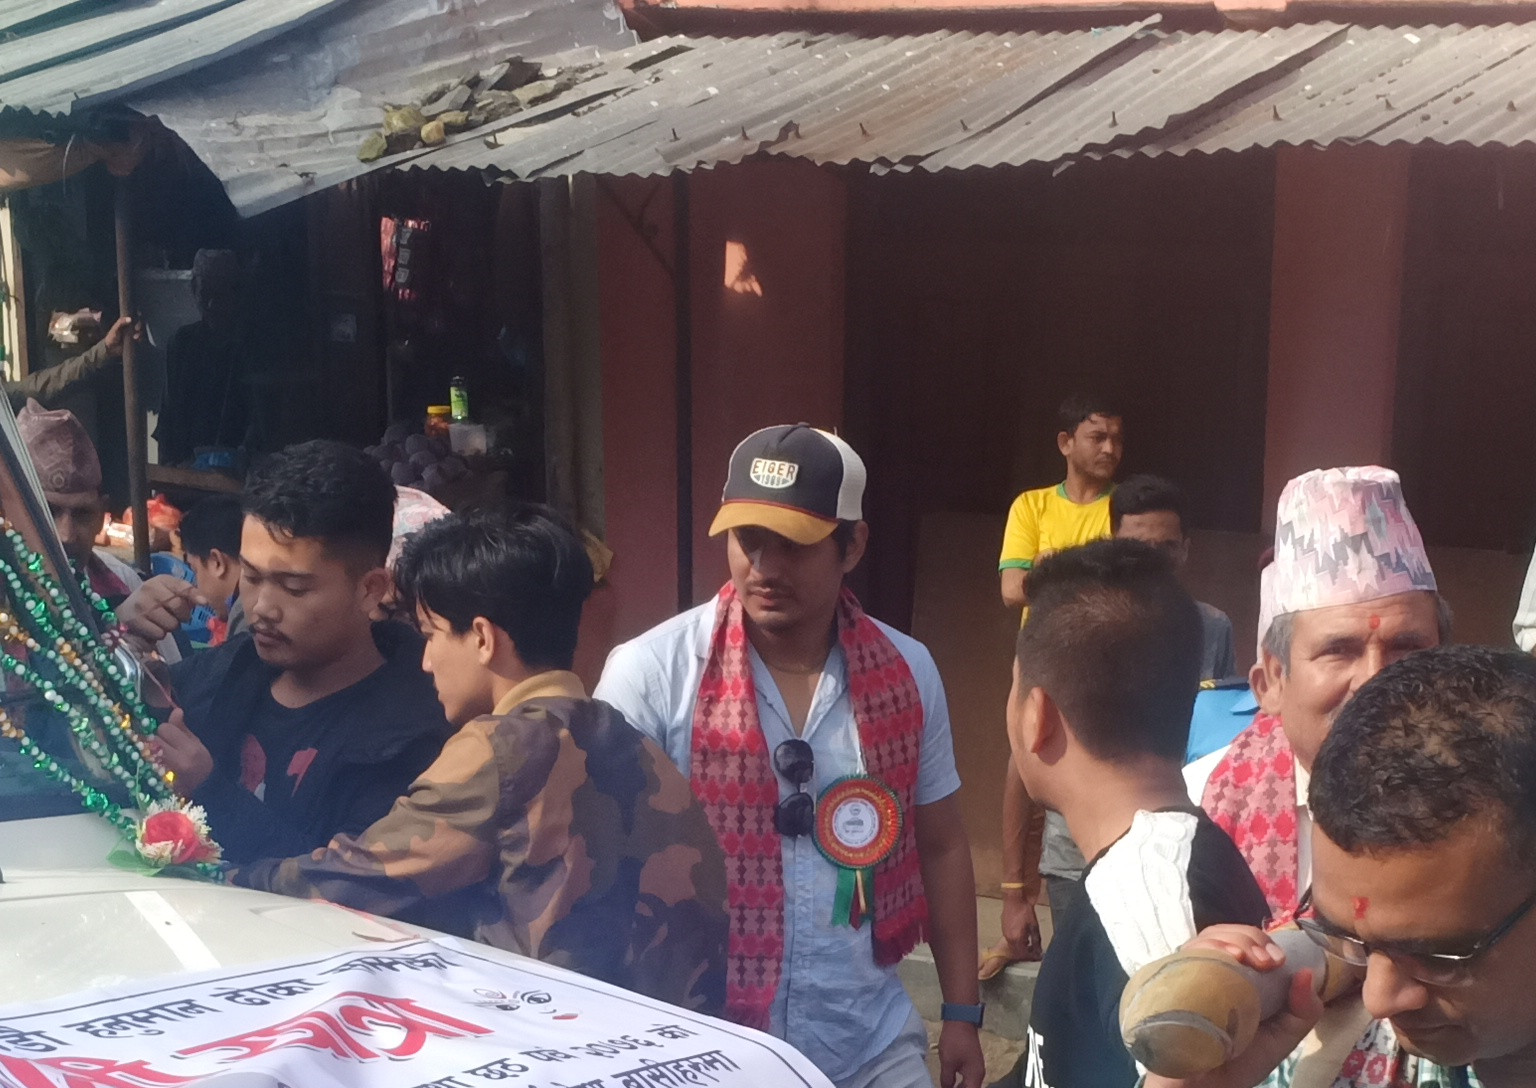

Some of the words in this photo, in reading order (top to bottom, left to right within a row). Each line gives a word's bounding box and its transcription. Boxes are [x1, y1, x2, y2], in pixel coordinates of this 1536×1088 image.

[752, 460, 796, 481] EIGER
[60, 999, 224, 1038] हनुमान
[210, 977, 326, 1008] ढोका
